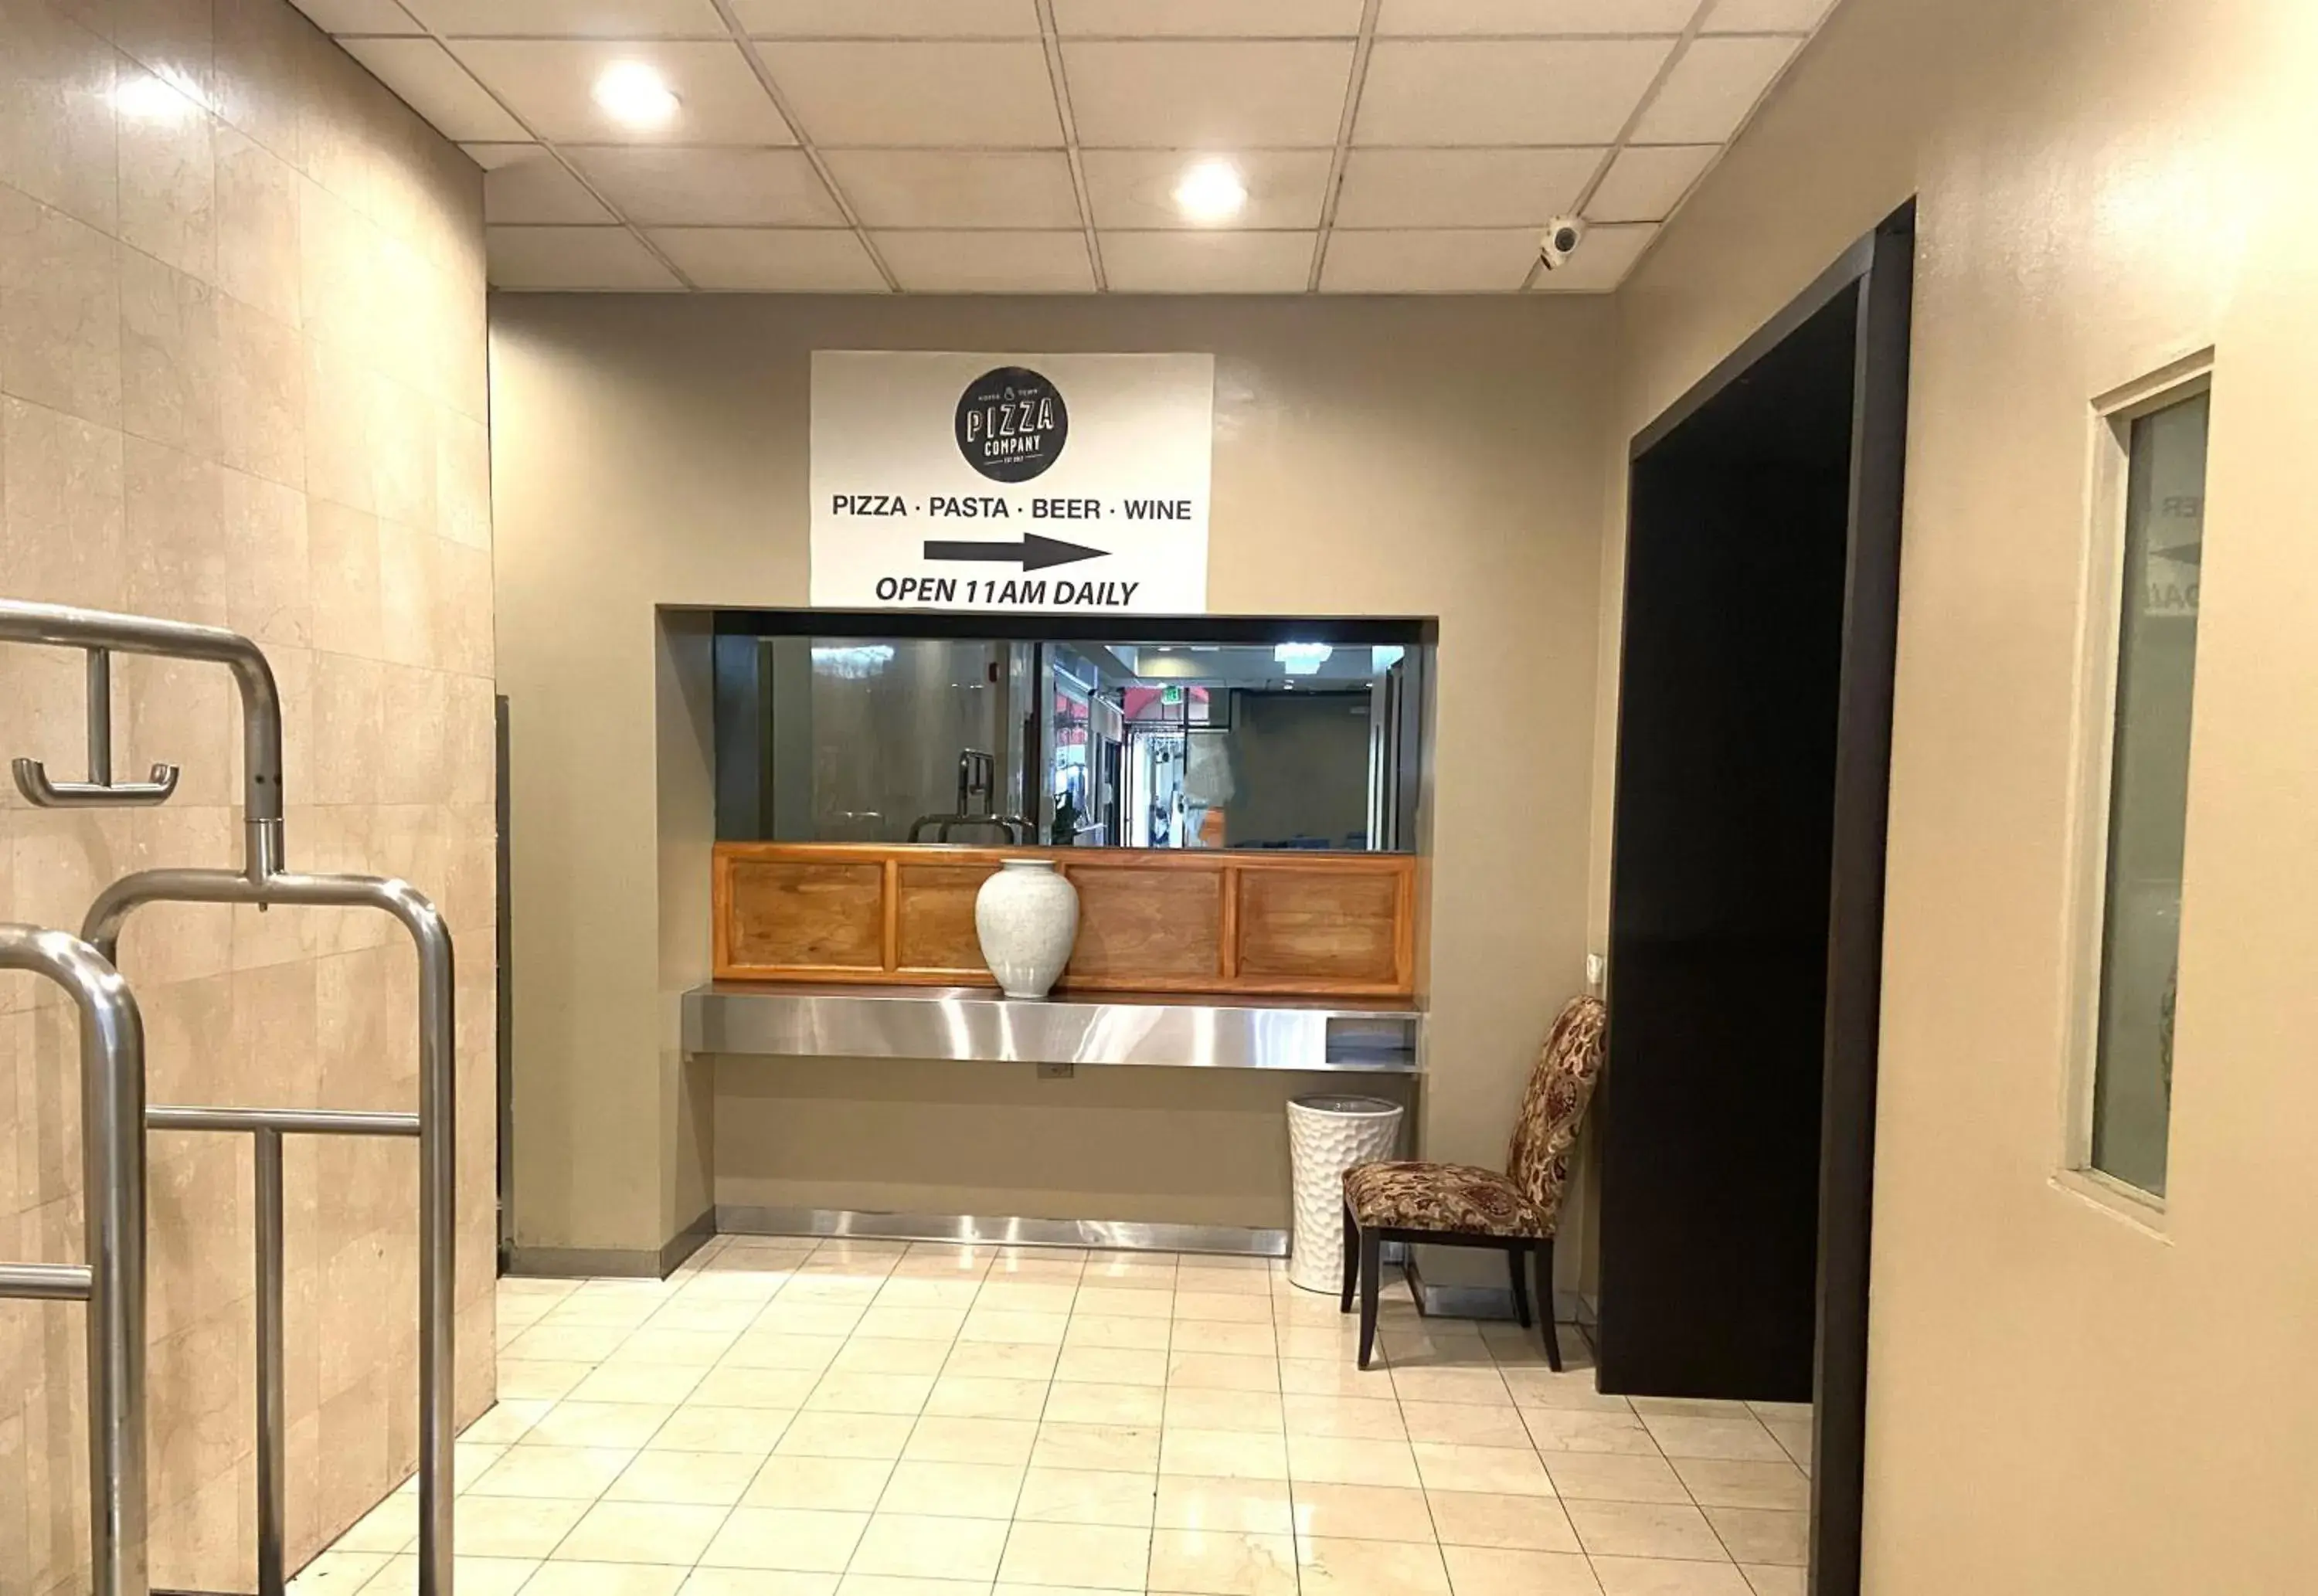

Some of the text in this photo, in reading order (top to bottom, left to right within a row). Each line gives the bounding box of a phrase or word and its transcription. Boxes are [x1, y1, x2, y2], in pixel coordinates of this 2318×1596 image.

[967, 397, 1054, 443] PIZZA
[984, 435, 1041, 457] COMPANY
[832, 495, 1192, 521] PIZZA PASTA BEER WINE
[875, 576, 1140, 607] OPEN 11AM DAILY
